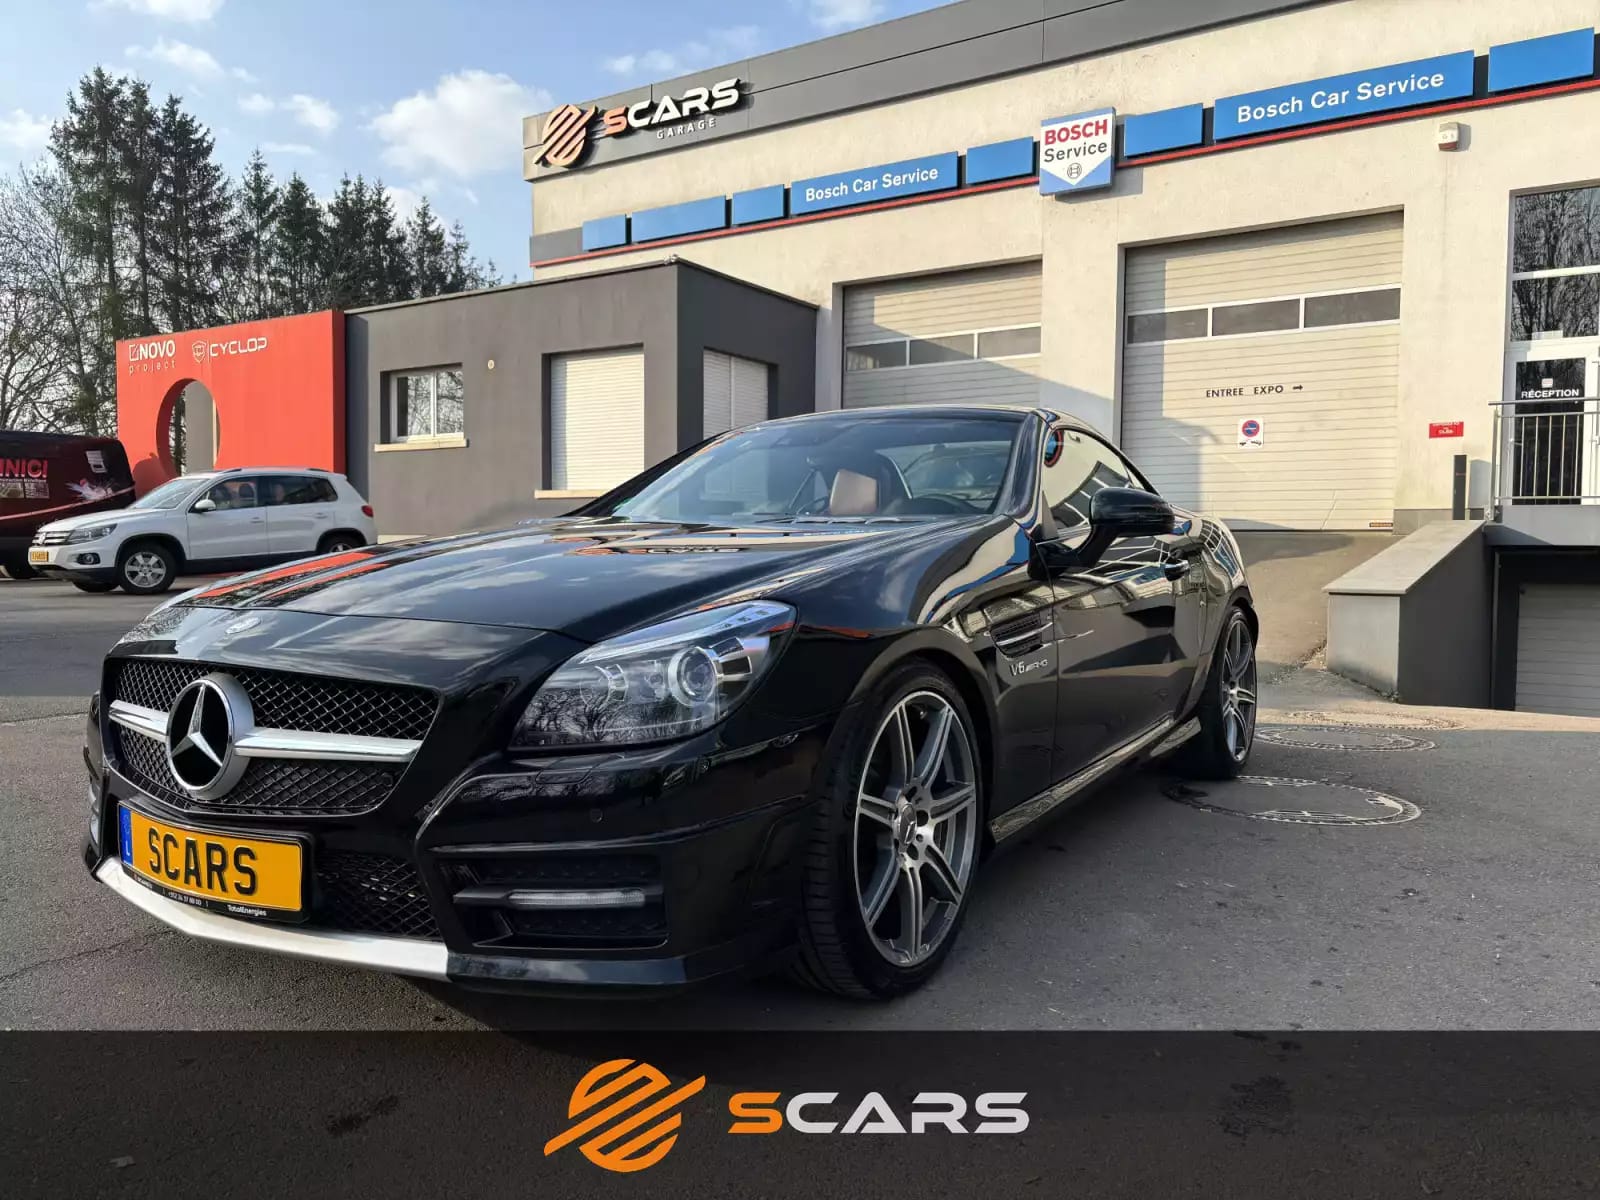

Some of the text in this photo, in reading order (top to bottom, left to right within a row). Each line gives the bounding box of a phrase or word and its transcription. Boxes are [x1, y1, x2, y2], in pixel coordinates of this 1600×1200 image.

[603, 77, 740, 136] SCARS
[1237, 73, 1445, 123] Bosch Car Service
[656, 117, 716, 139] GARAGE
[1045, 119, 1107, 145] BOSCH
[1044, 142, 1107, 163] Service
[805, 168, 939, 202] Bosch Car Service
[209, 337, 268, 357] CYCLOP
[129, 359, 176, 375] project
[1206, 385, 1284, 398] ENTREE EXPO
[1521, 388, 1580, 399] RÉCEPTION
[1010, 661, 1025, 676] V6
[148, 826, 258, 896] SCARS
[227, 904, 267, 917] TotalEnergies
